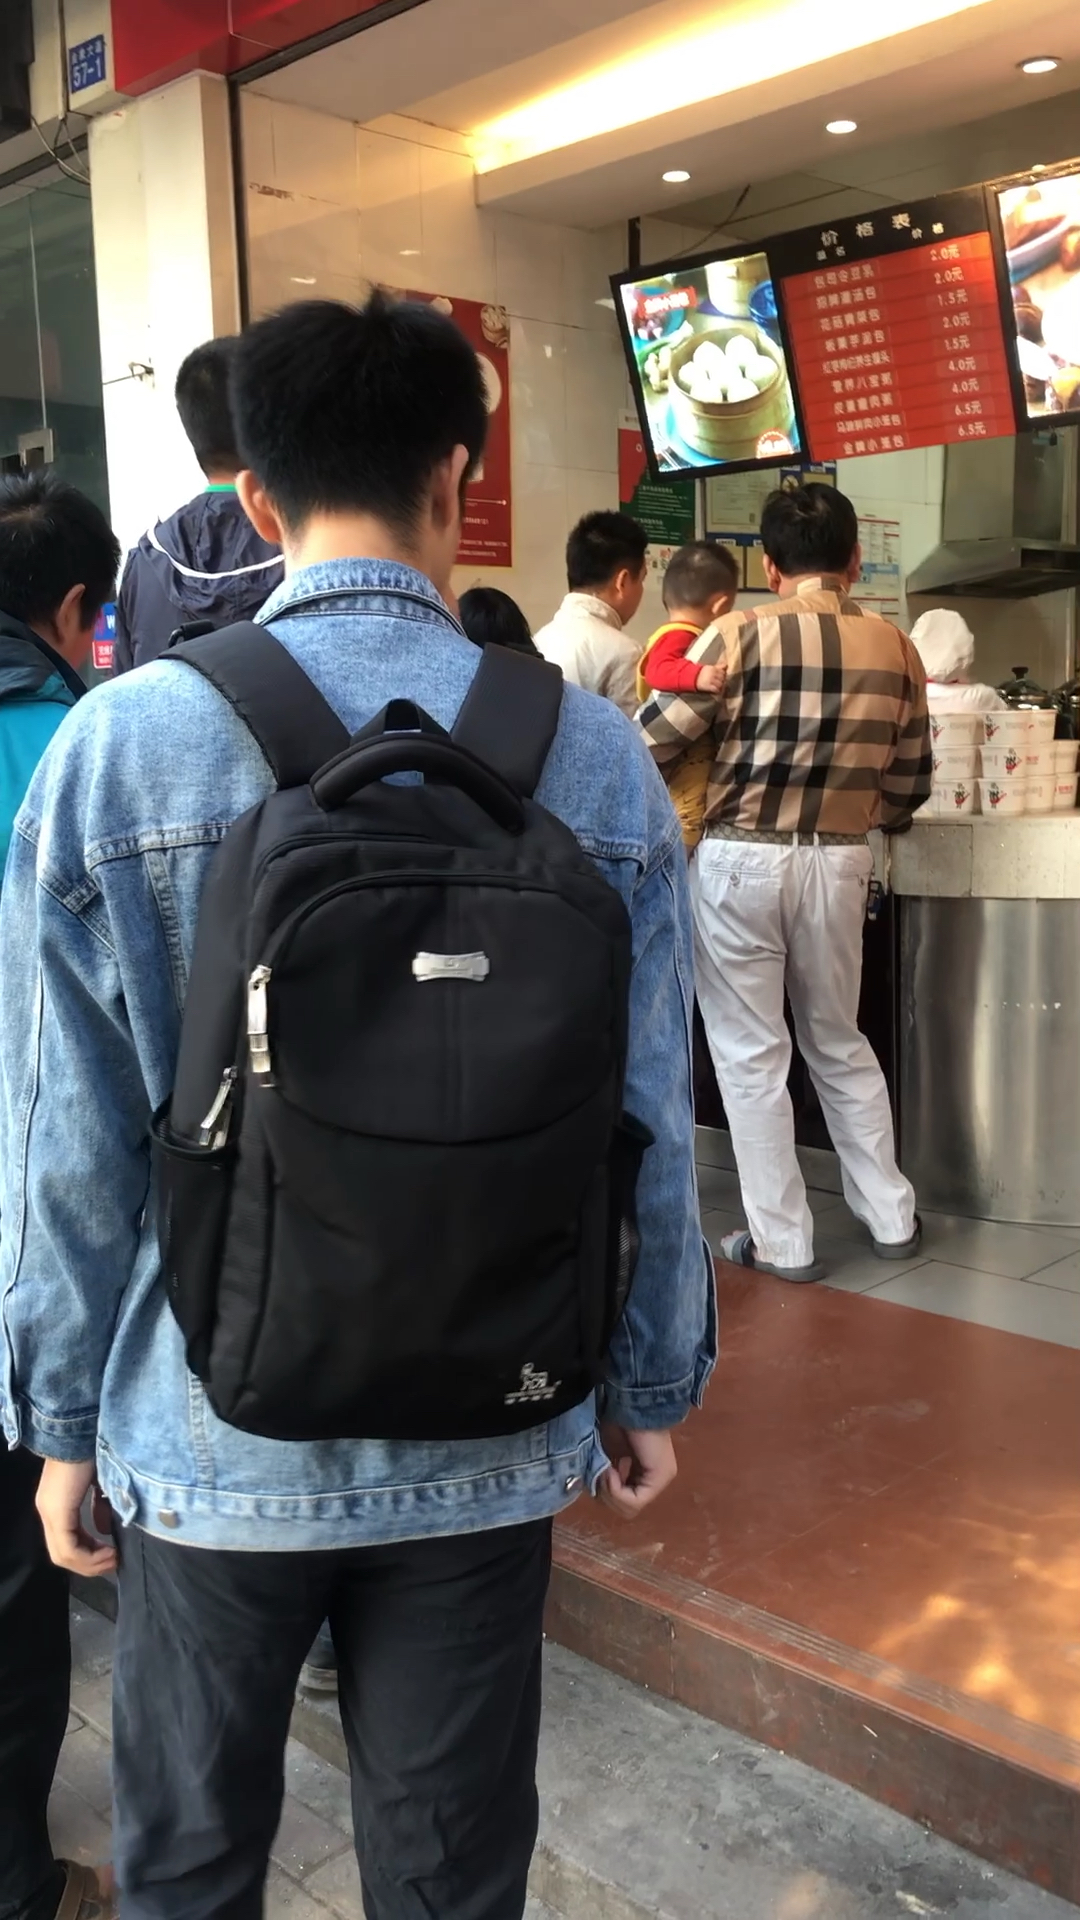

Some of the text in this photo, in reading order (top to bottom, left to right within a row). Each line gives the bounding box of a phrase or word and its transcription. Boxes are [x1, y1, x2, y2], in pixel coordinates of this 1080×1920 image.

[73, 57, 102, 88] 57-1
[821, 212, 910, 247] 价格表
[930, 243, 960, 261] 2.0元
[934, 266, 964, 285] 2.0元
[938, 288, 969, 307] 1.5元
[942, 311, 971, 329] 2.0元
[944, 334, 971, 351] 1.5元
[948, 356, 977, 372] 4.0元
[951, 377, 980, 394] 4.0元
[954, 400, 982, 416] 6.5元
[957, 421, 987, 437] 6.5元
